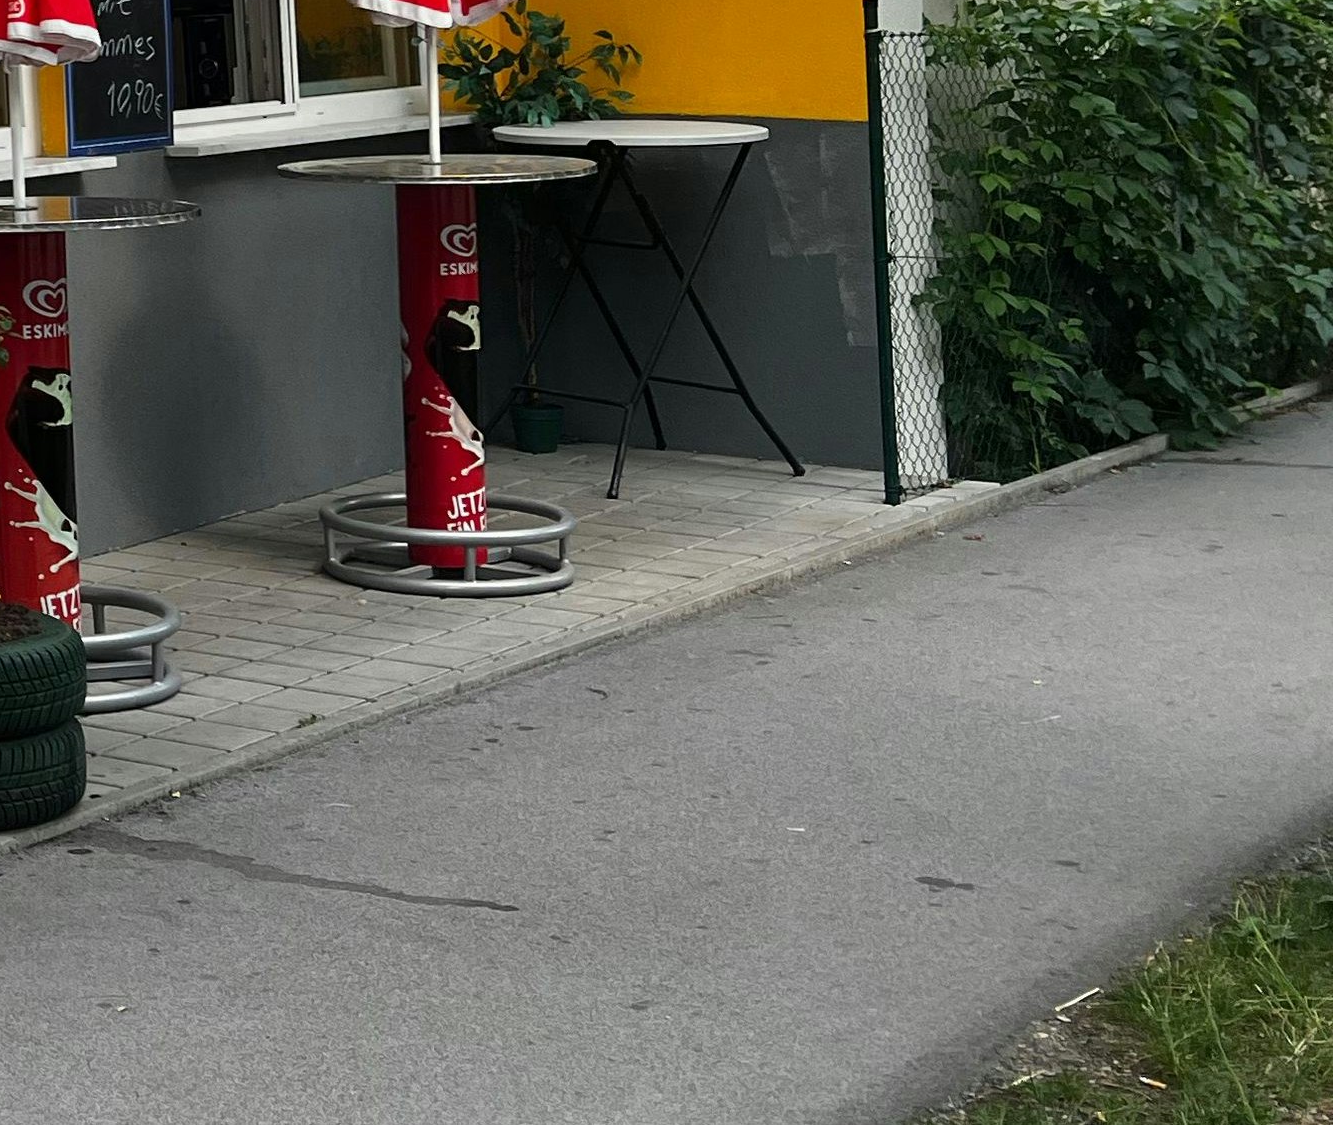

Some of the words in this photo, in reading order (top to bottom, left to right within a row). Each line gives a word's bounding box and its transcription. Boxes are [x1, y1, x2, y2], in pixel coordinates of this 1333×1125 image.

[100, 34, 156, 62] mmes
[106, 78, 165, 121] 10,90€
[439, 260, 479, 276] ESKIM
[22, 322, 70, 340] ESKIM
